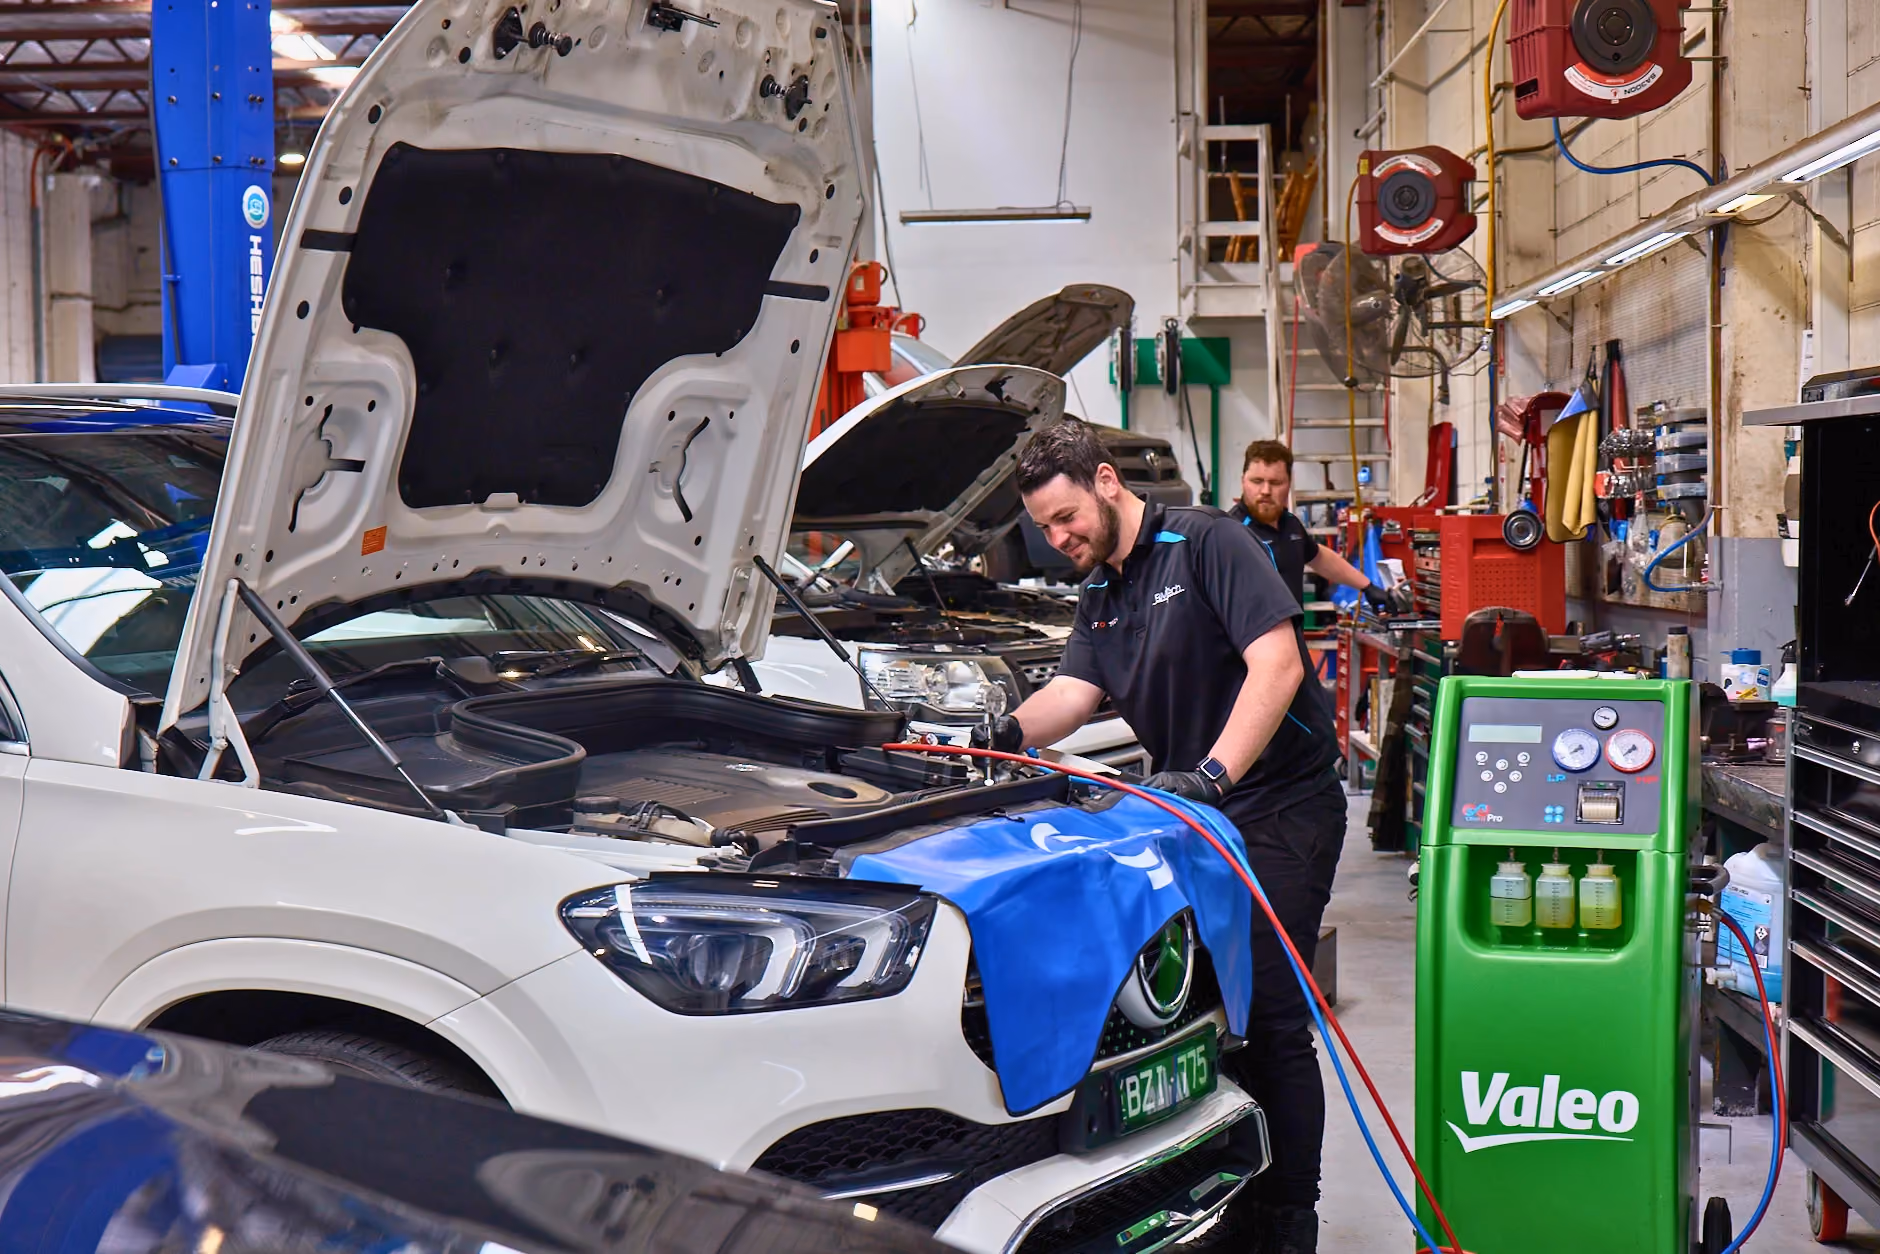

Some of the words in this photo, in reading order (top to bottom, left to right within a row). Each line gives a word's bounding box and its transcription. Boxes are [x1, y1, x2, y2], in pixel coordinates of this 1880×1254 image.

[1547, 774, 1566, 783] LP
[1487, 814, 1503, 822] Pro
[1461, 1071, 1640, 1133] Valeo
